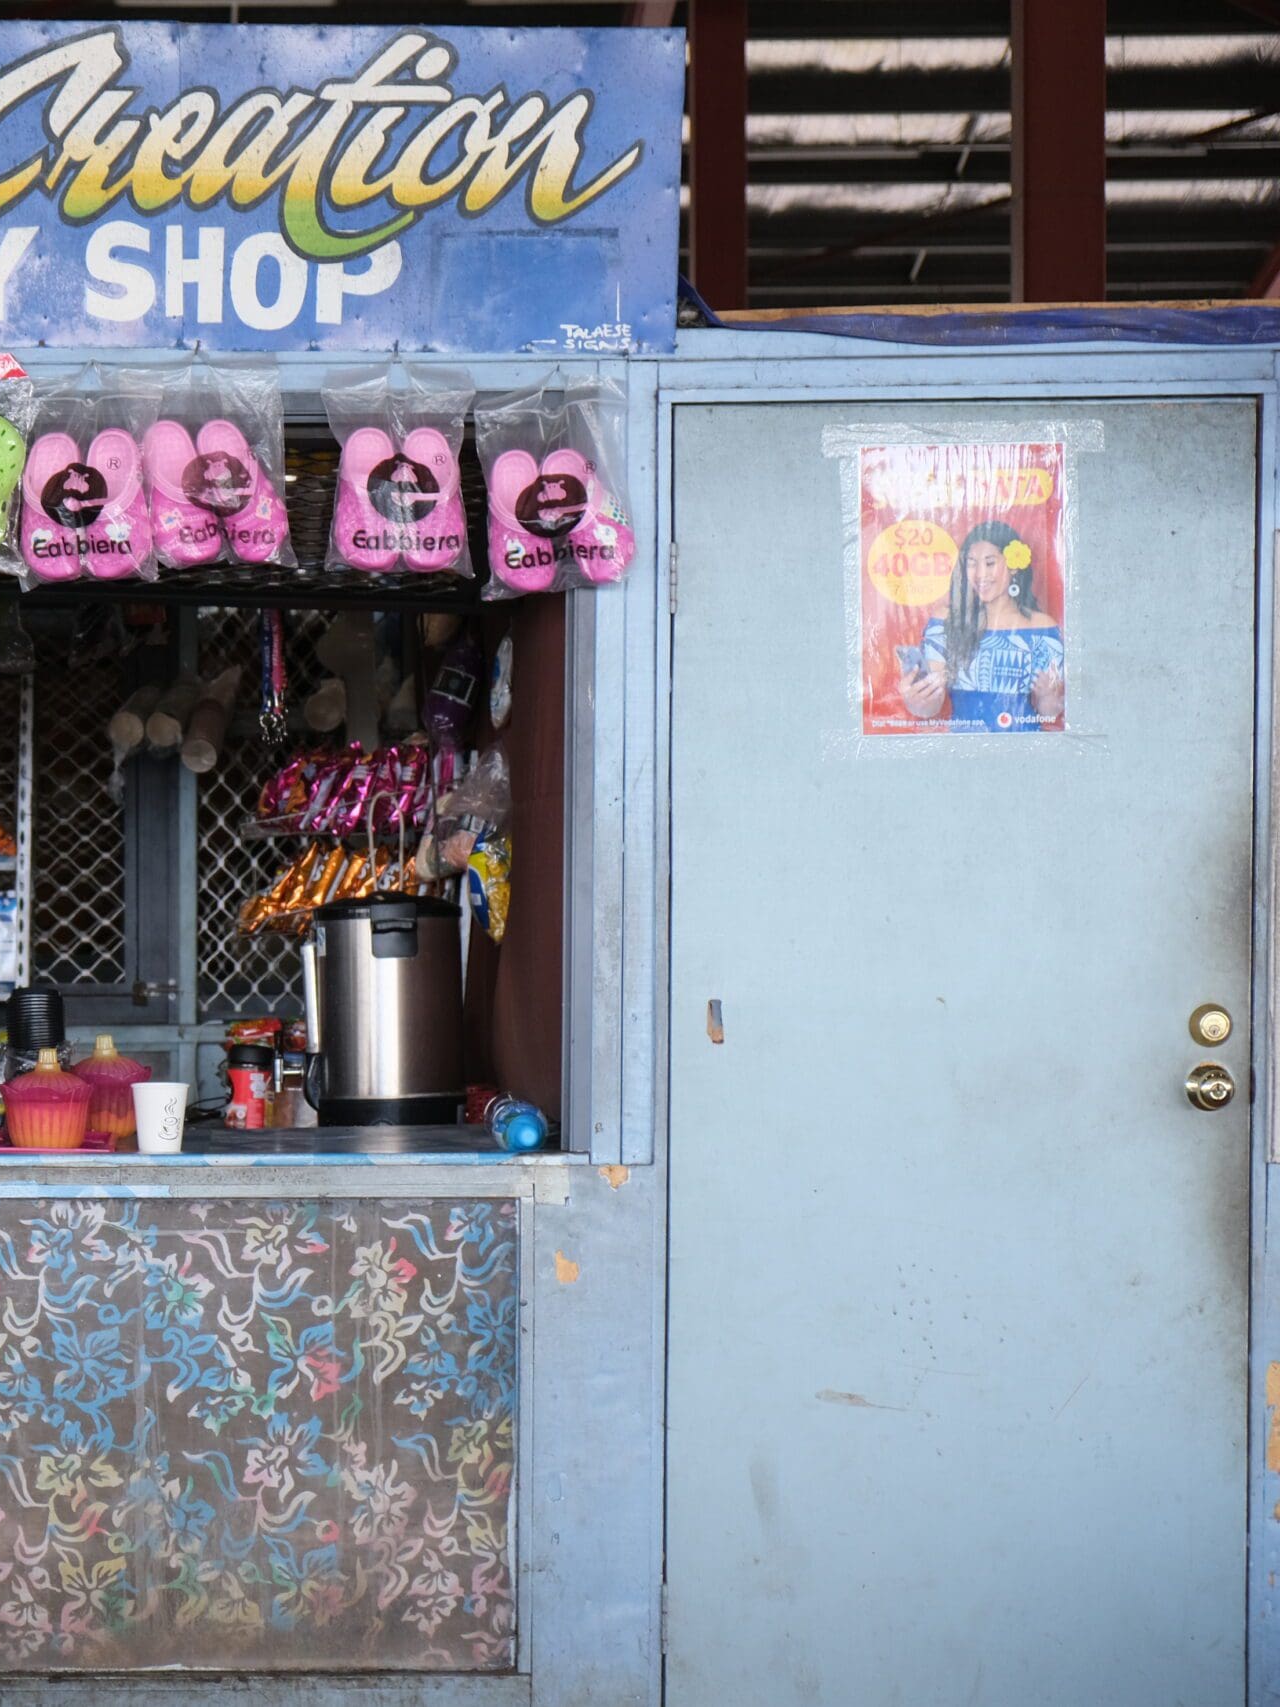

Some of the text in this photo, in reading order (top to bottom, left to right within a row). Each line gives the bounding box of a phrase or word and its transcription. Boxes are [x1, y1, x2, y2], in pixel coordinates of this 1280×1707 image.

[84, 220, 403, 331] SHOP
[563, 338, 631, 351] SIGNS
[33, 534, 132, 558] Eabbiera
[352, 529, 460, 551] Eabbiera
[894, 525, 933, 550] $20
[505, 540, 615, 569] Eabbiera
[873, 551, 952, 577] 40GB
[1014, 714, 1056, 724] vodafone
